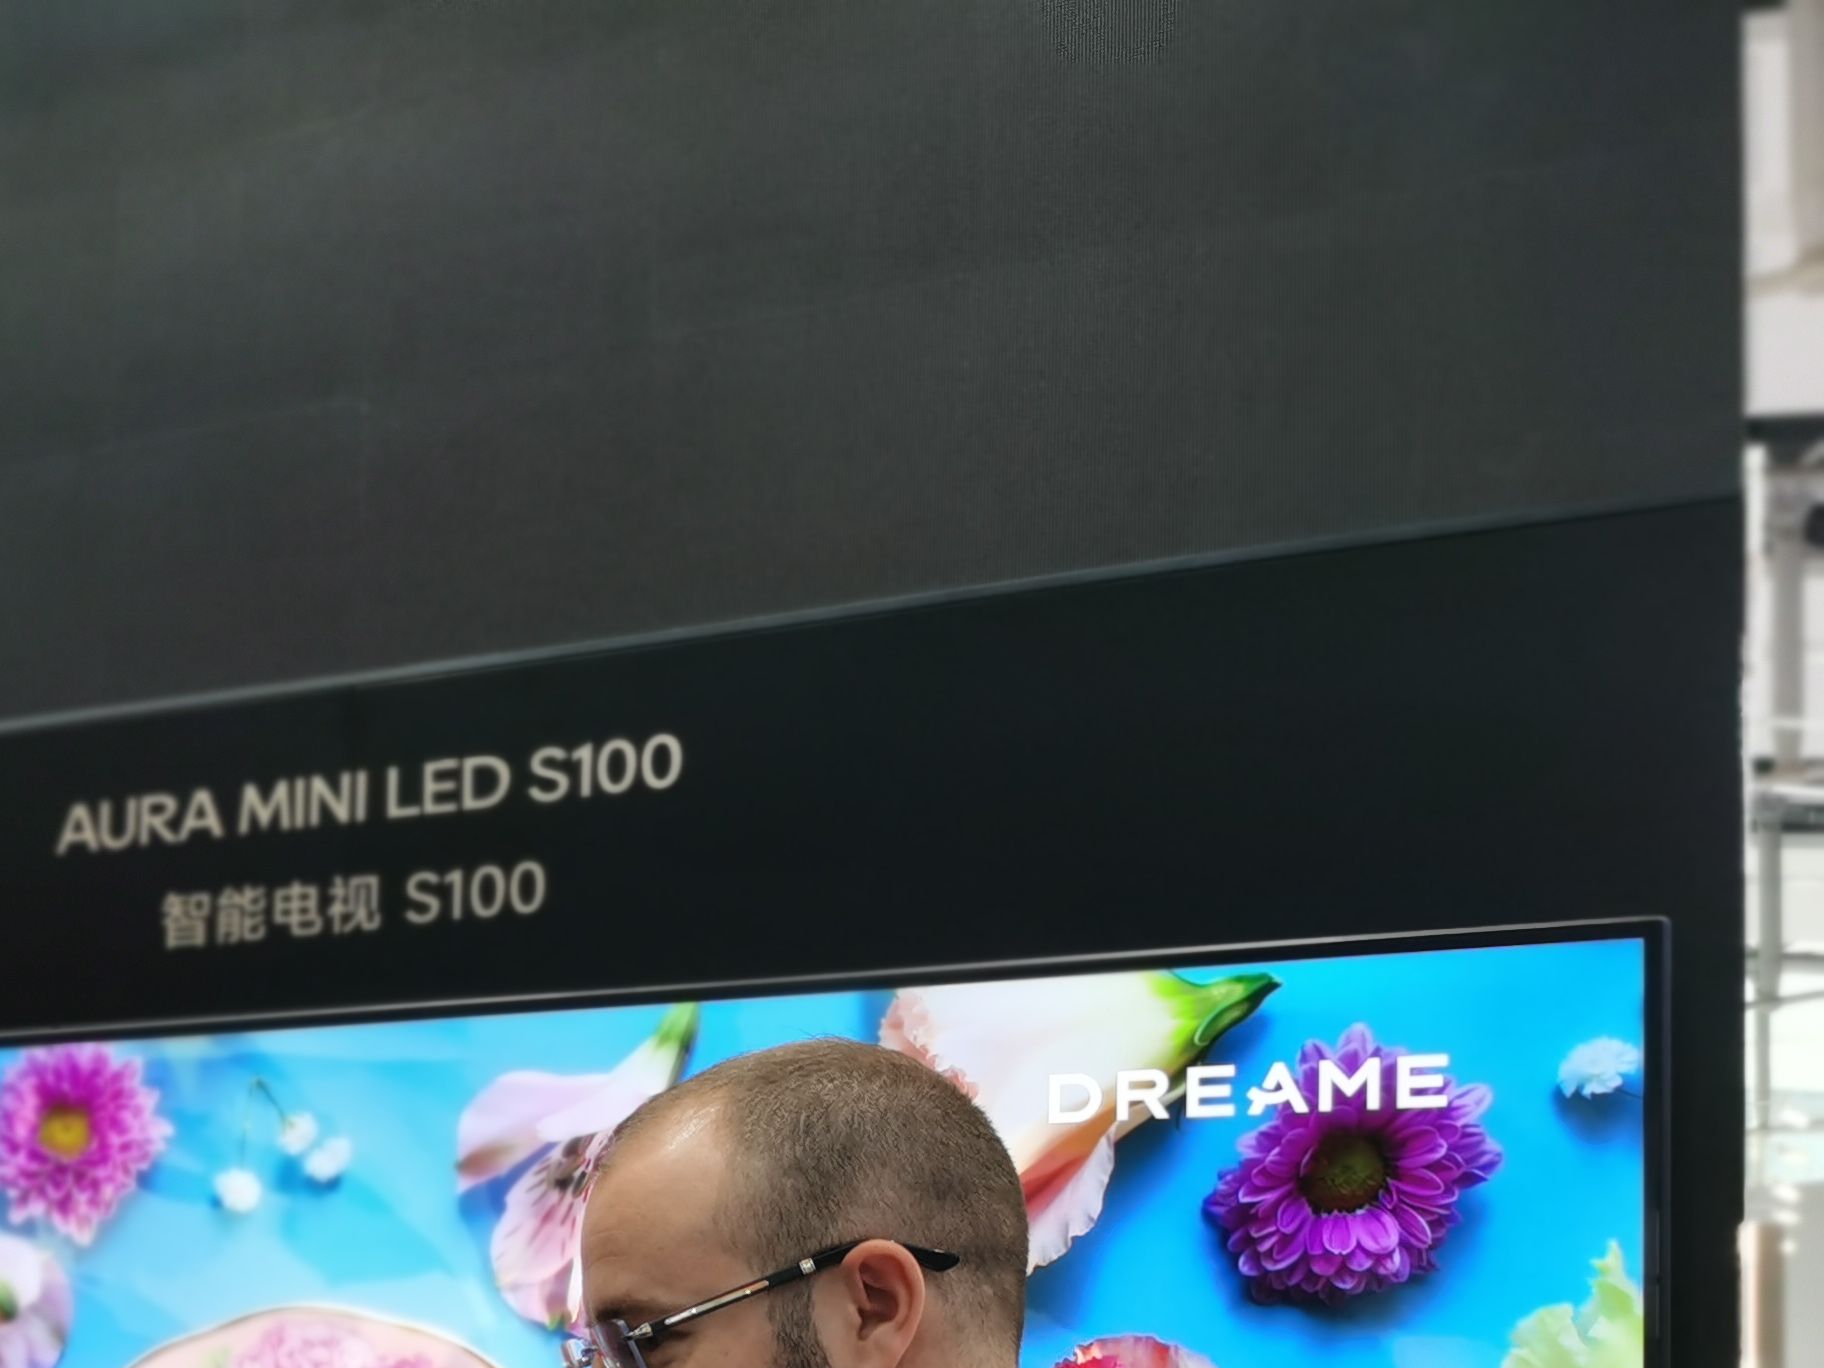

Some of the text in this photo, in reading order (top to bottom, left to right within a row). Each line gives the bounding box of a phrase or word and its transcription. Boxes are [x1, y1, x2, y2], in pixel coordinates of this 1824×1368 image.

[54, 733, 683, 855] AURA MINI LED S100
[160, 860, 546, 949] 智能电视 S100
[1047, 1053, 1450, 1125] DREAME
